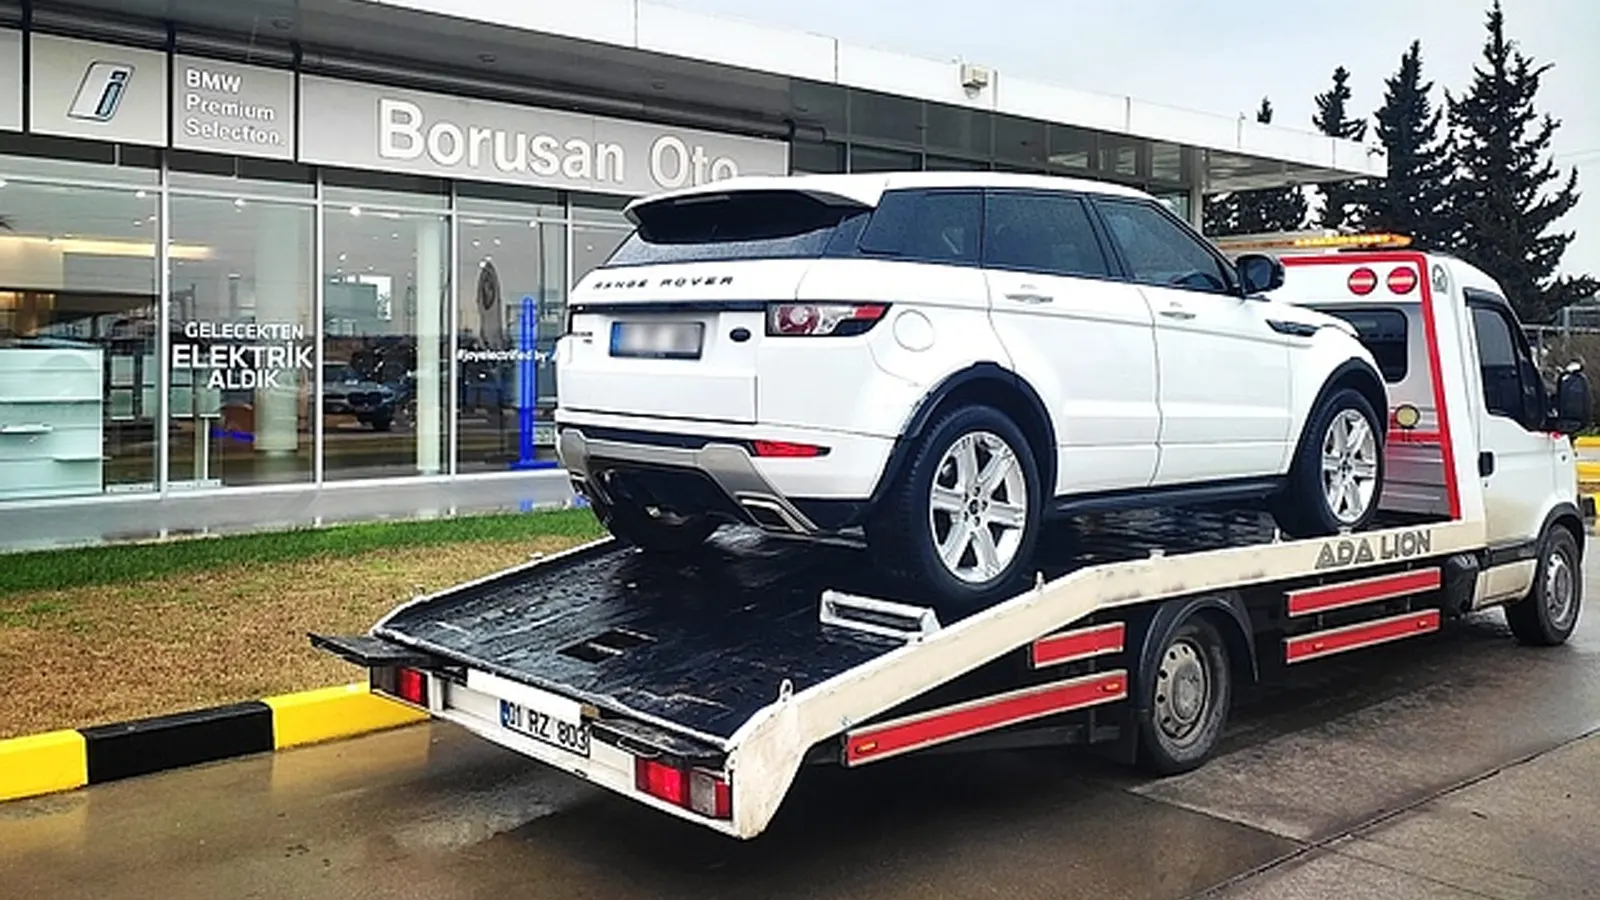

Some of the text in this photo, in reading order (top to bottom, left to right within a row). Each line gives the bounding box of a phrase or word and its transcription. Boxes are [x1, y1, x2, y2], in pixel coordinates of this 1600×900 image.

[186, 69, 241, 92] BMW
[186, 94, 274, 120] Premium
[379, 99, 625, 182] Borusan
[660, 276, 733, 288] ROVER
[184, 322, 304, 340] GELECEKTEN
[172, 341, 313, 369] ELEKTRİK
[207, 369, 280, 389] ALDIK
[1315, 529, 1431, 569] ADA LION
[528, 709, 551, 738] RZ
